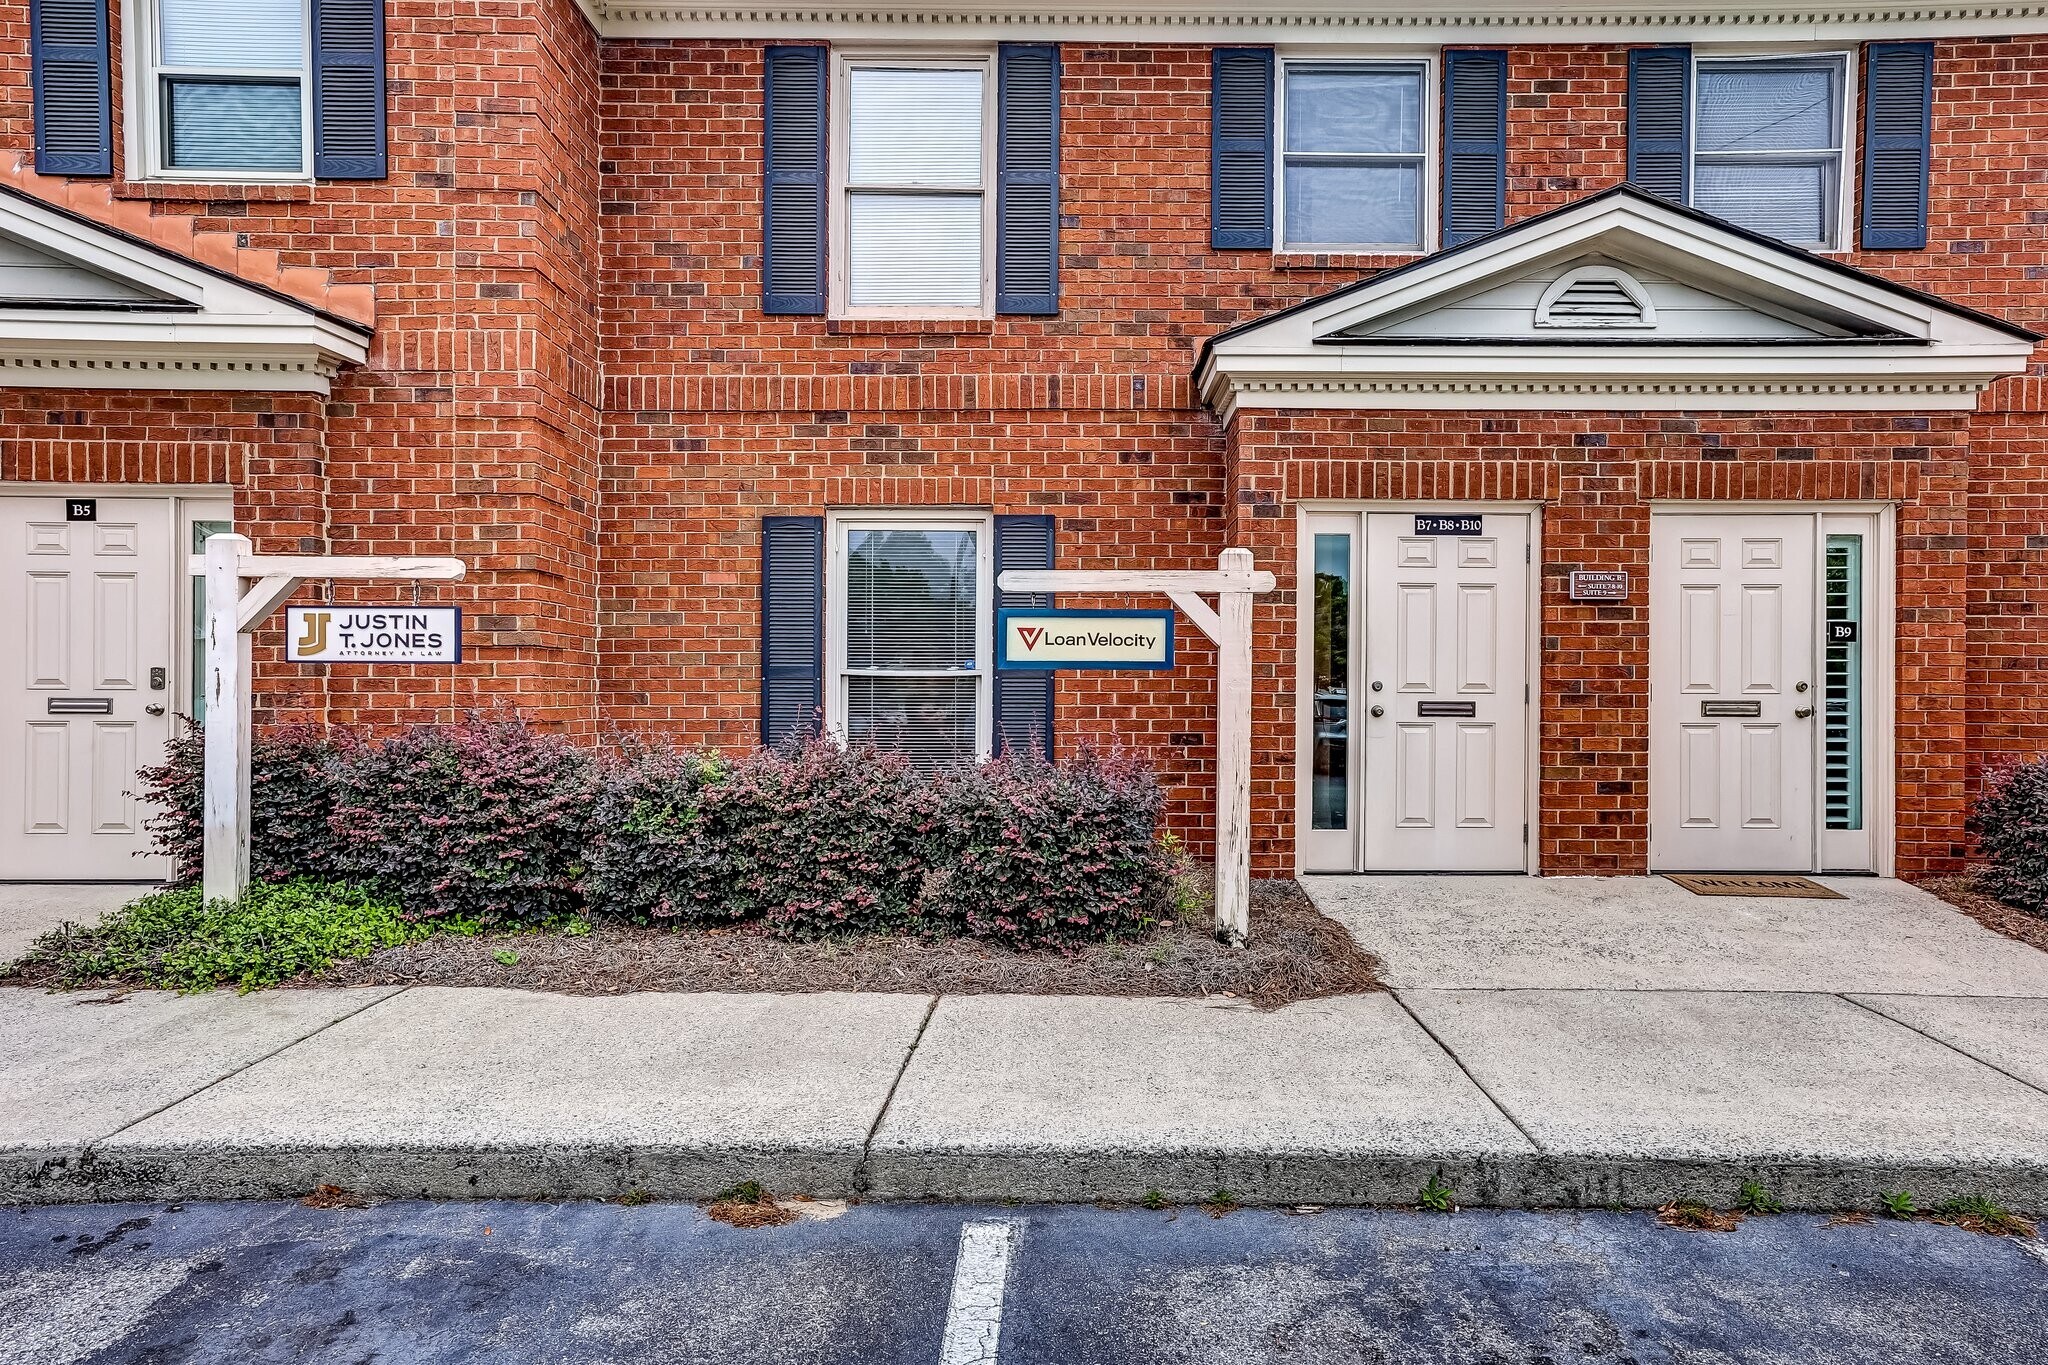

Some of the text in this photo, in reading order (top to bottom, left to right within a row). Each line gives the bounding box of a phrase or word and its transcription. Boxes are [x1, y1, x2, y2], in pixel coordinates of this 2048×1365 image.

[72, 504, 91, 516] B5
[339, 614, 427, 630] JUSTIN
[1834, 626, 1852, 638] B9
[339, 633, 442, 648] T. JONES
[1689, 878, 1814, 890] WELCOME
